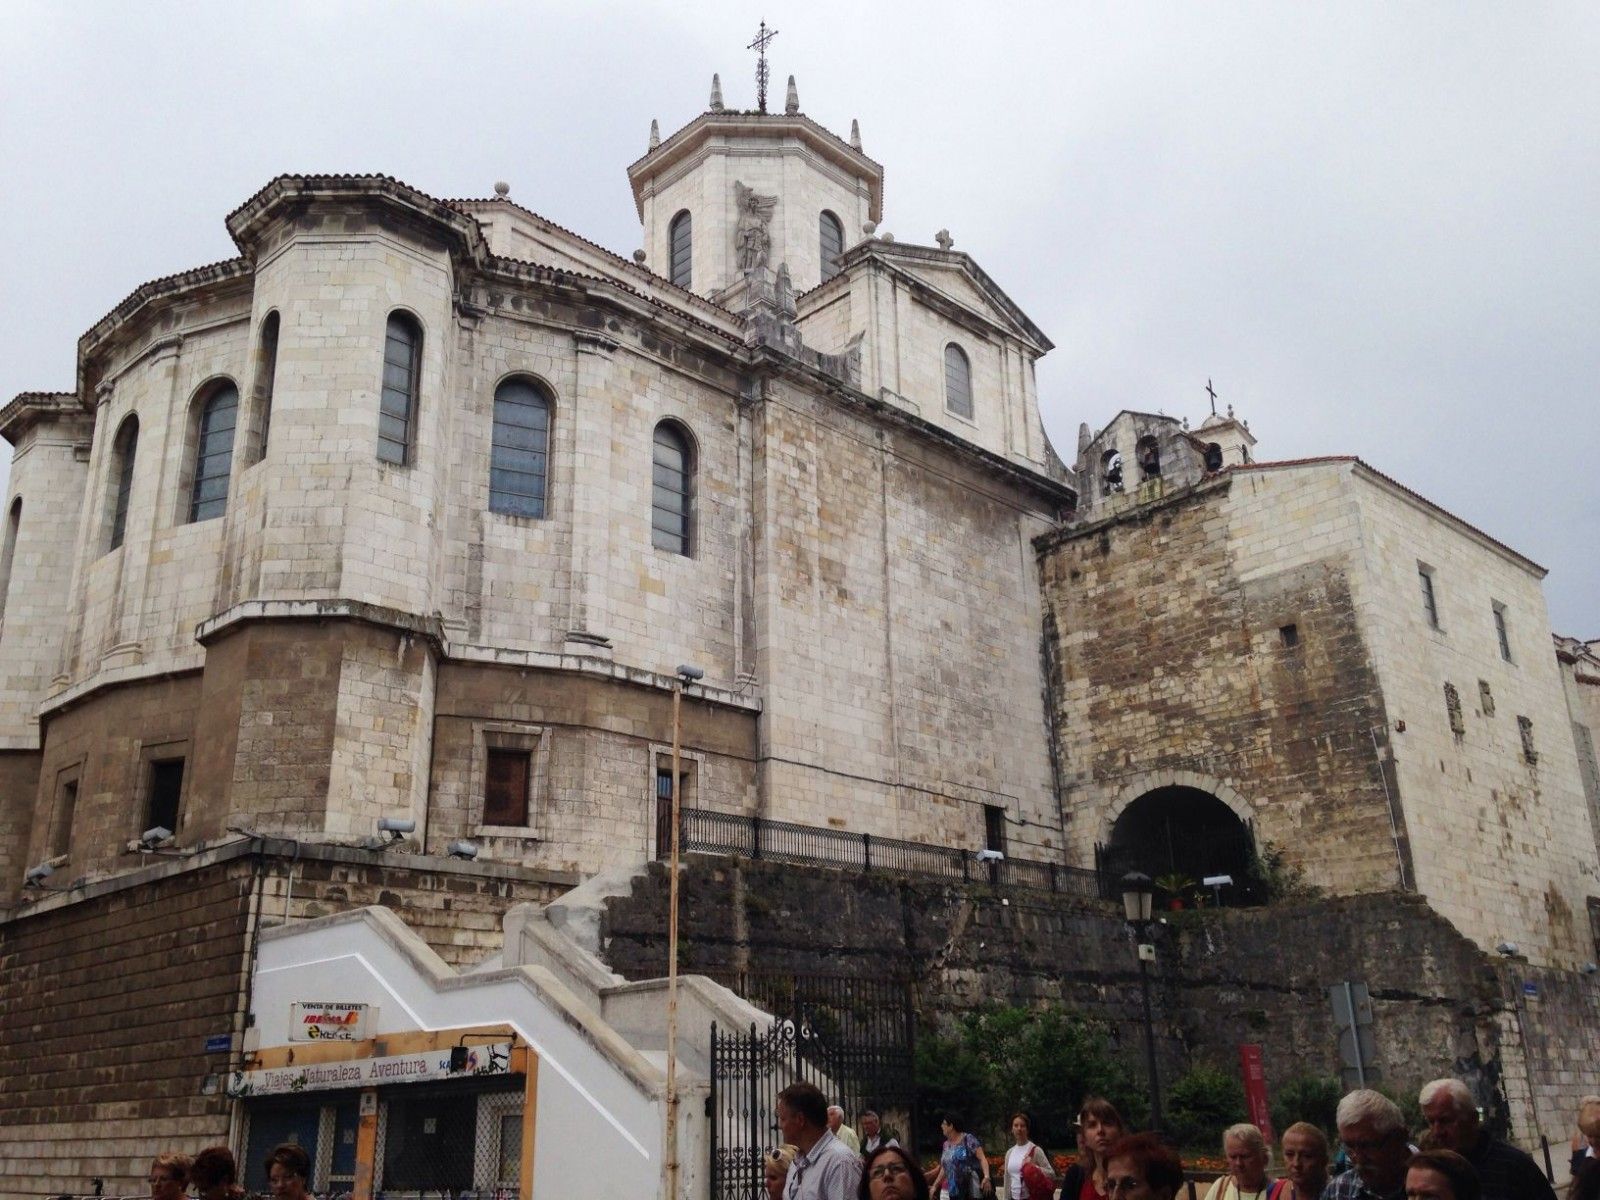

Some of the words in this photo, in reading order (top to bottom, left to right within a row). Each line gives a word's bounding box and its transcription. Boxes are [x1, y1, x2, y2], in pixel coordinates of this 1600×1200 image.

[264, 1072, 294, 1090] Viajes
[302, 1064, 361, 1084] Naturaleza
[369, 1059, 427, 1078] Aventura
